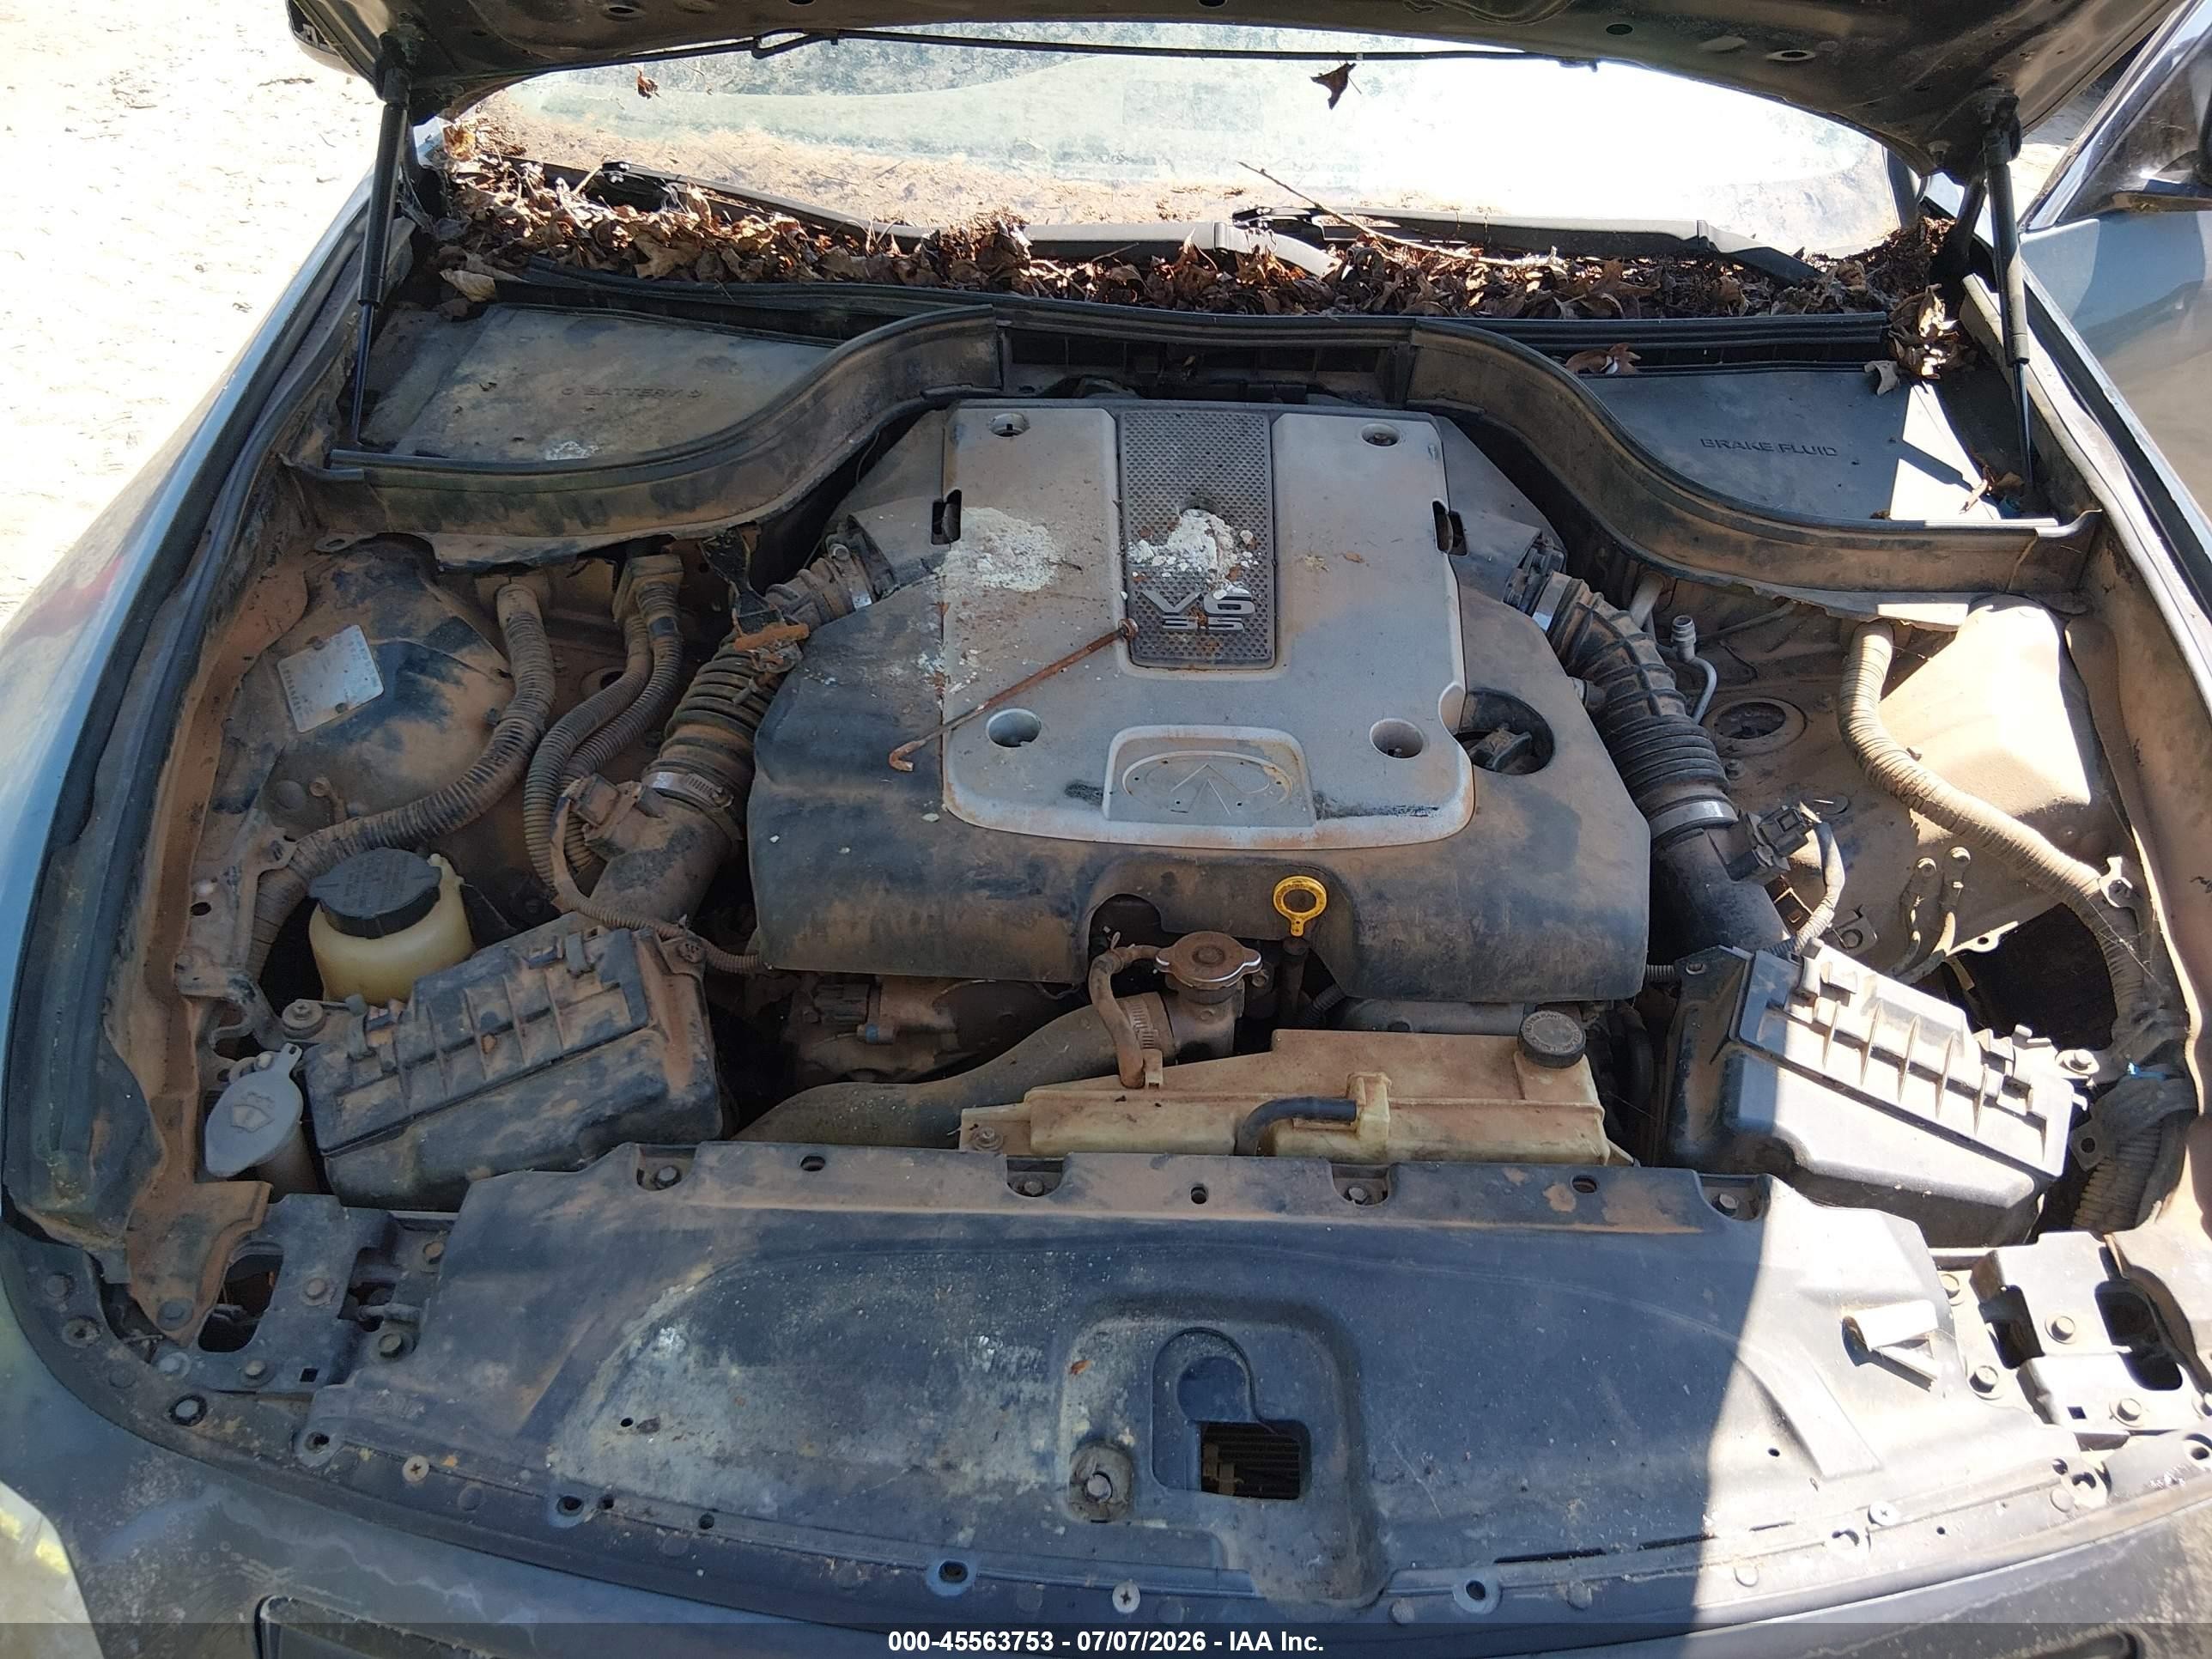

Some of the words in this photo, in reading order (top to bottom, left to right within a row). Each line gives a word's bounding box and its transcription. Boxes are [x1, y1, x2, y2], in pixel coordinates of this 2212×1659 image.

[583, 387, 684, 399] BATTERY
[1700, 438, 1774, 452] BRAKE
[1778, 443, 1838, 456] FLUID
[1140, 585, 1255, 616] V6
